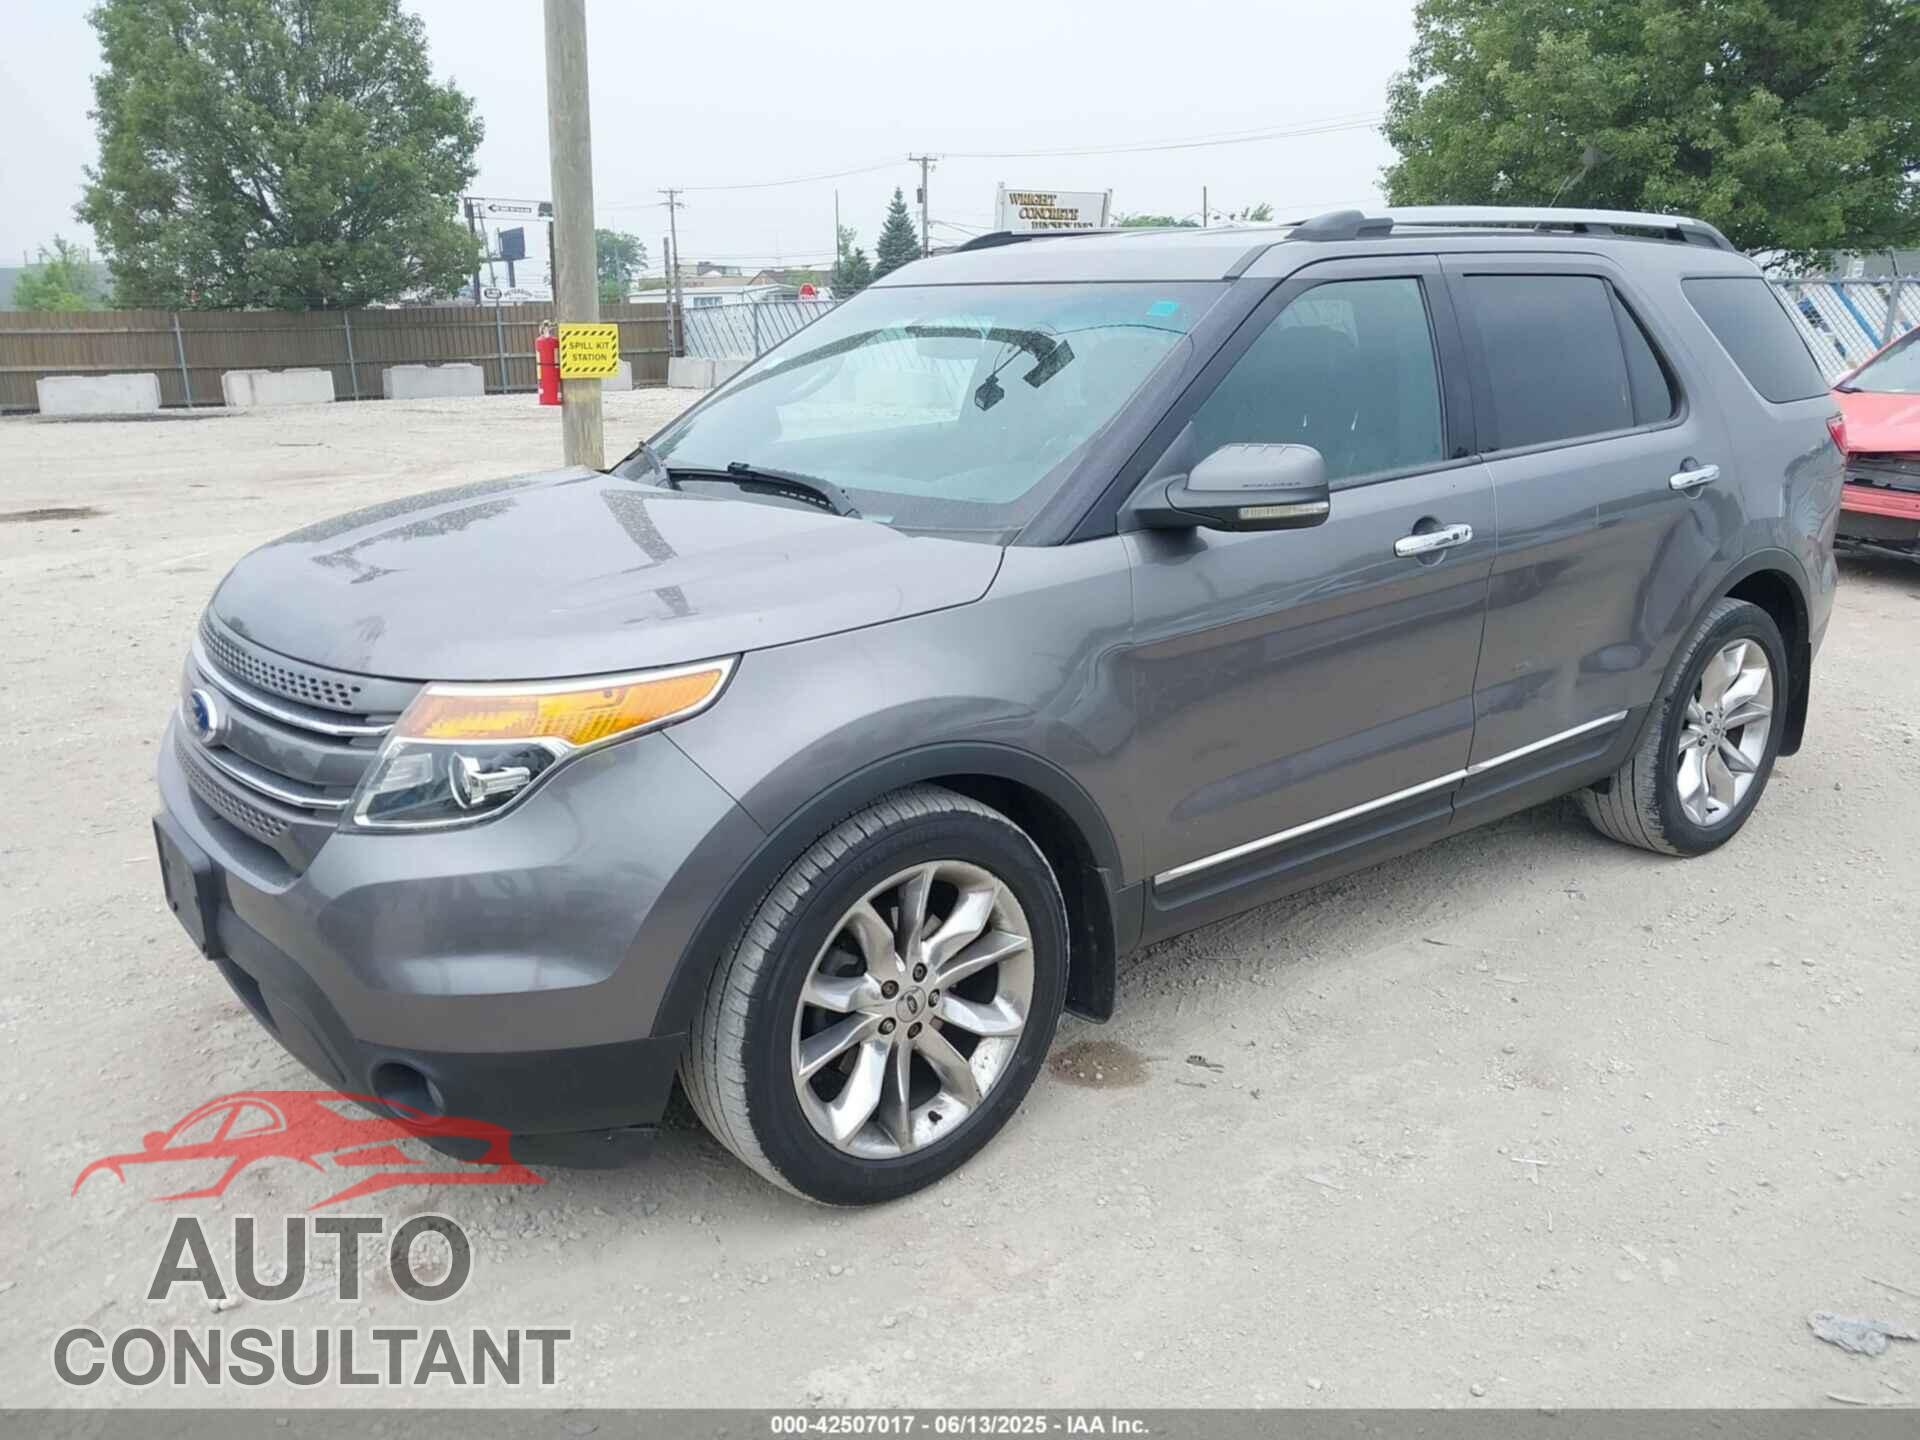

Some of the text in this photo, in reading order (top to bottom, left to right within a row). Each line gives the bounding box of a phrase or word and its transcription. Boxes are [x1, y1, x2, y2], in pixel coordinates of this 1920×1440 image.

[1019, 207, 1079, 220] CONCRETE
[569, 341, 609, 350] SPILL KIT
[572, 353, 607, 361] STATION
